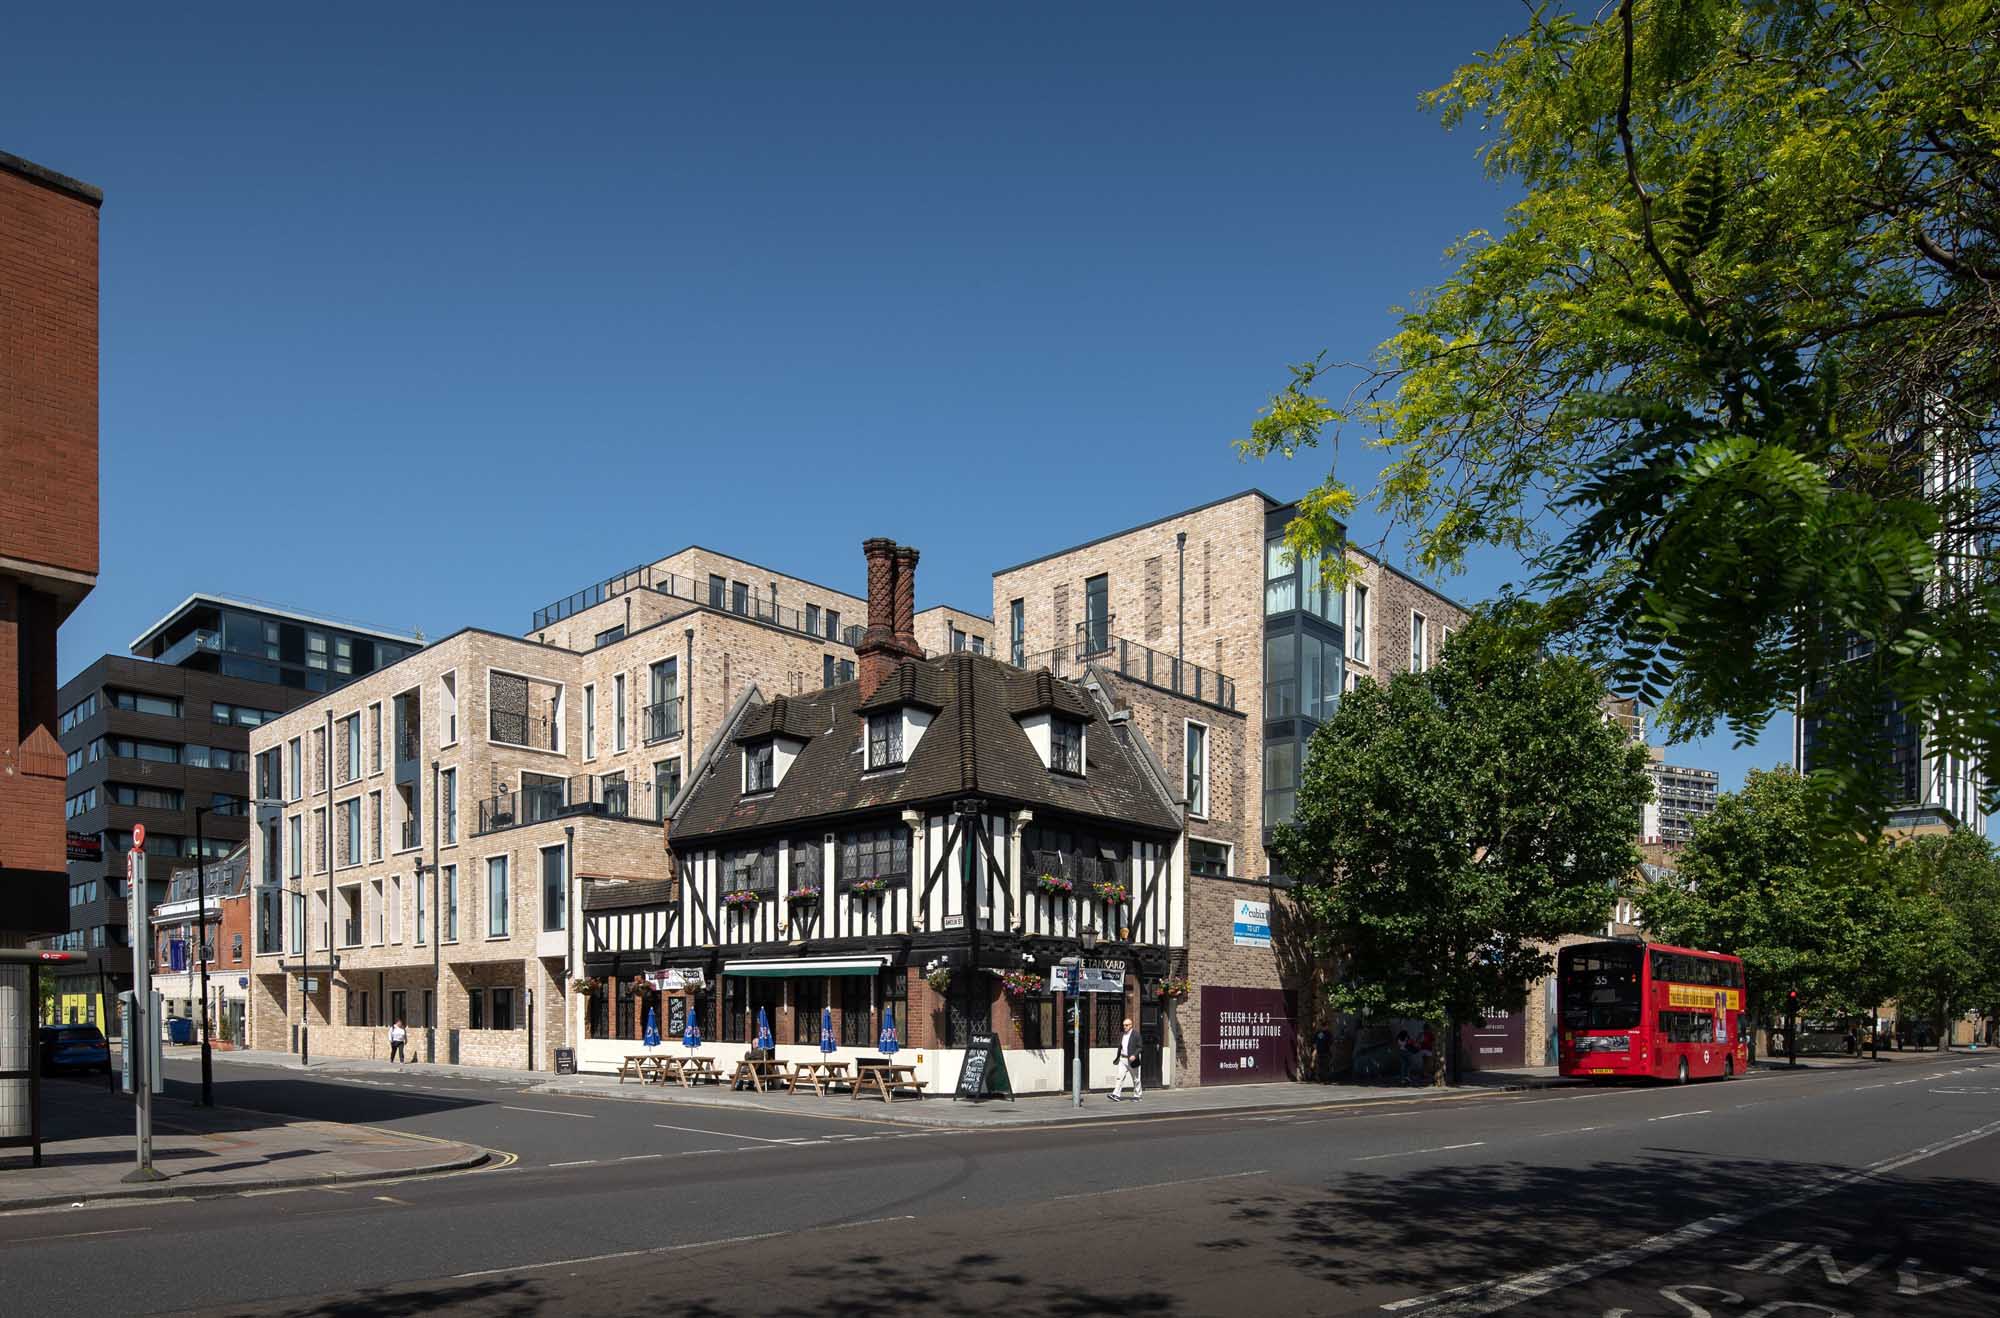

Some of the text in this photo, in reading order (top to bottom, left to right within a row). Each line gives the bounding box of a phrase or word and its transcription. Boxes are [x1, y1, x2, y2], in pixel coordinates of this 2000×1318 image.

[134, 829, 140, 844] C
[1220, 1012, 1246, 1024] STYLISH
[1220, 1026, 1281, 1037] BEDROOM BOUTIQUE
[1220, 1039, 1259, 1050] APARTMENTS
